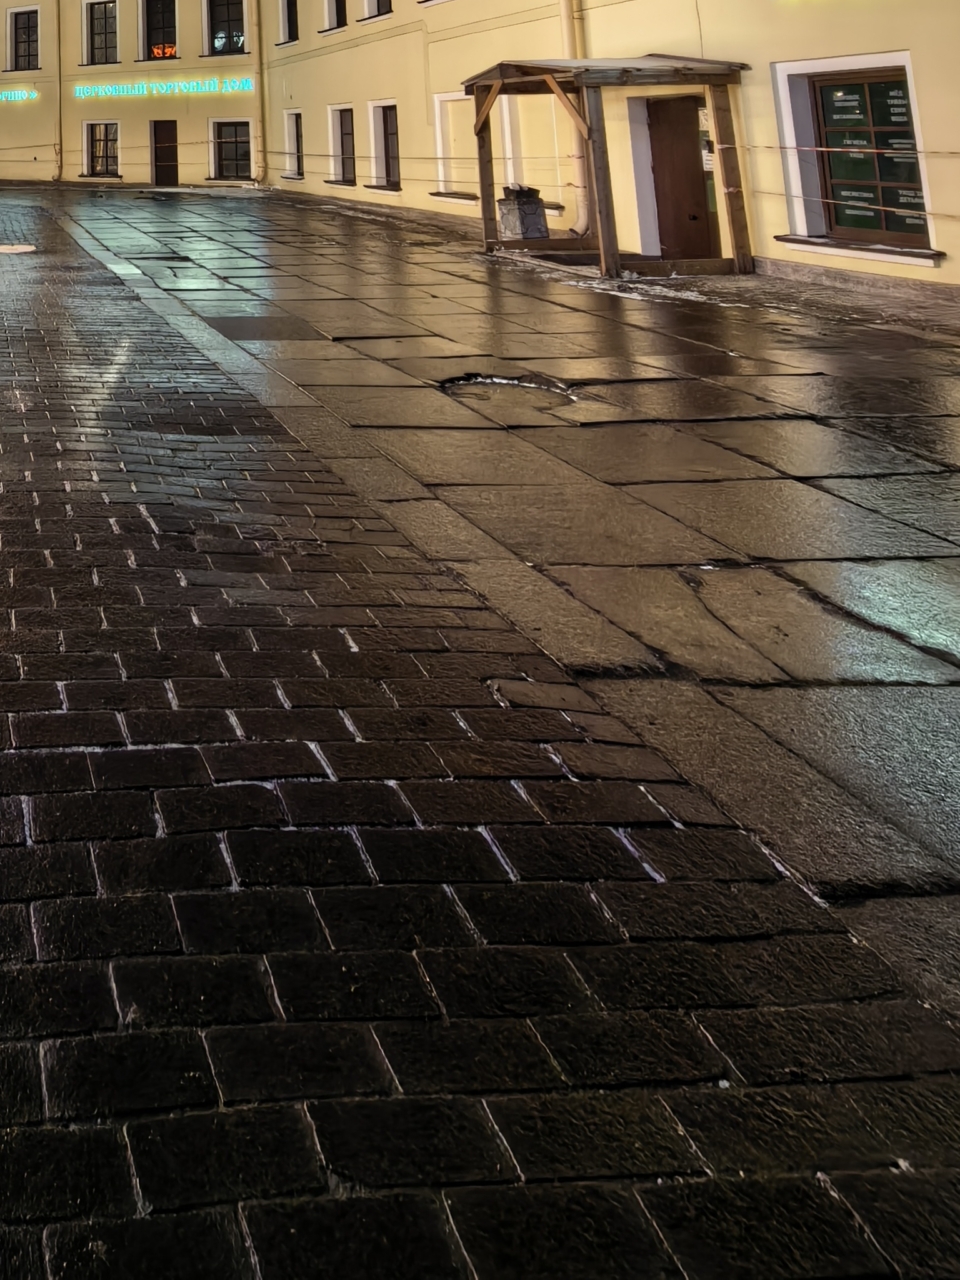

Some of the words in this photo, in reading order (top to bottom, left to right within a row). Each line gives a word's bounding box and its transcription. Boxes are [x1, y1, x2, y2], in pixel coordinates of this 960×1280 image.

[74, 82, 147, 99] ЦЕРКОВНЫЙ
[149, 77, 219, 95] ТОРГОВЫЙ
[221, 77, 253, 94] ДОМ
